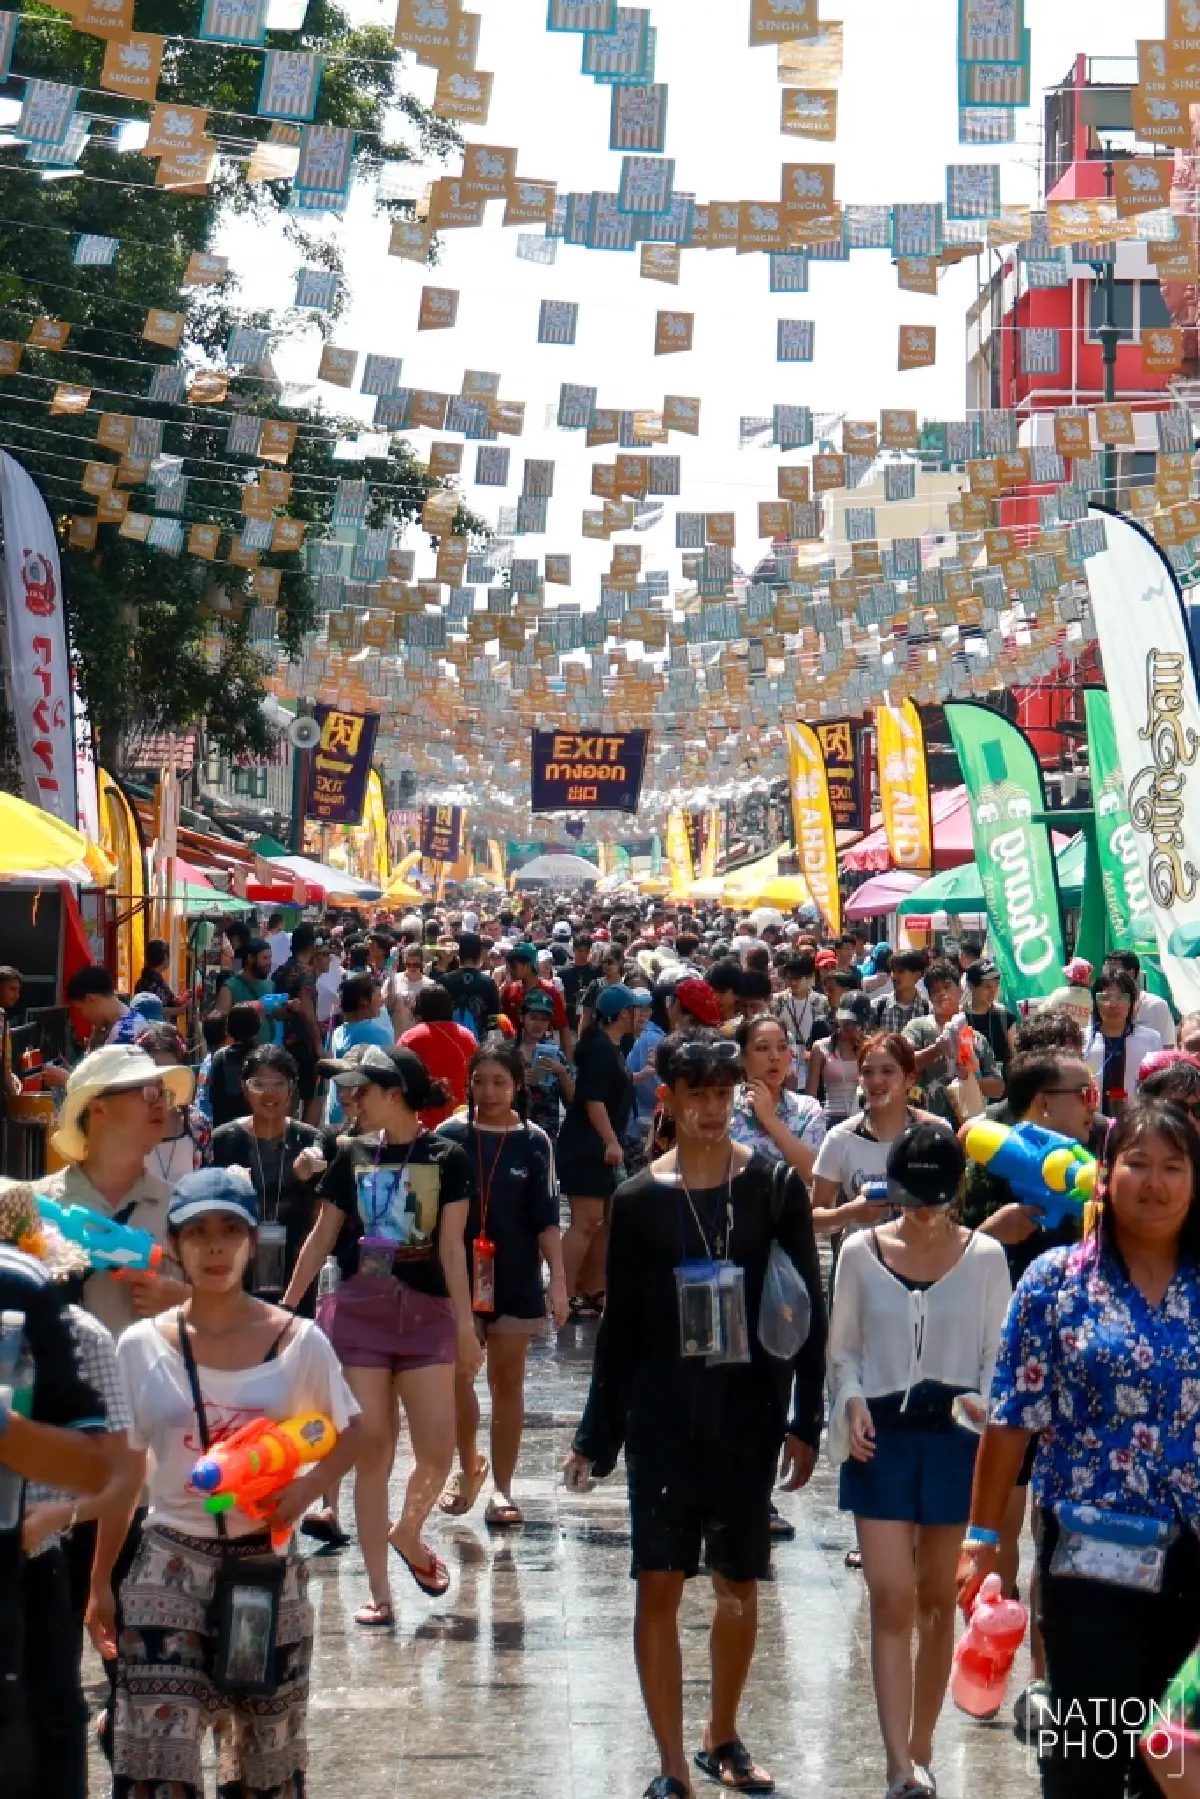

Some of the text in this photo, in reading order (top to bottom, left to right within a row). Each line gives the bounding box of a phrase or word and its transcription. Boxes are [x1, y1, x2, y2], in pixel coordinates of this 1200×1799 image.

[757, 19, 809, 32] SINGHA
[401, 31, 450, 46] SINGHA
[108, 72, 150, 86] SINGHA
[1141, 125, 1185, 136] SINGHA
[466, 182, 507, 192] SINGHA
[786, 201, 828, 211] SINGHA
[1122, 195, 1164, 205] SINGHA
[742, 233, 781, 243] SINGHA
[552, 736, 625, 761] EXIT
[545, 763, 626, 781] ทางออก
[316, 775, 346, 792] EXIT
[567, 785, 598, 801] 出口
